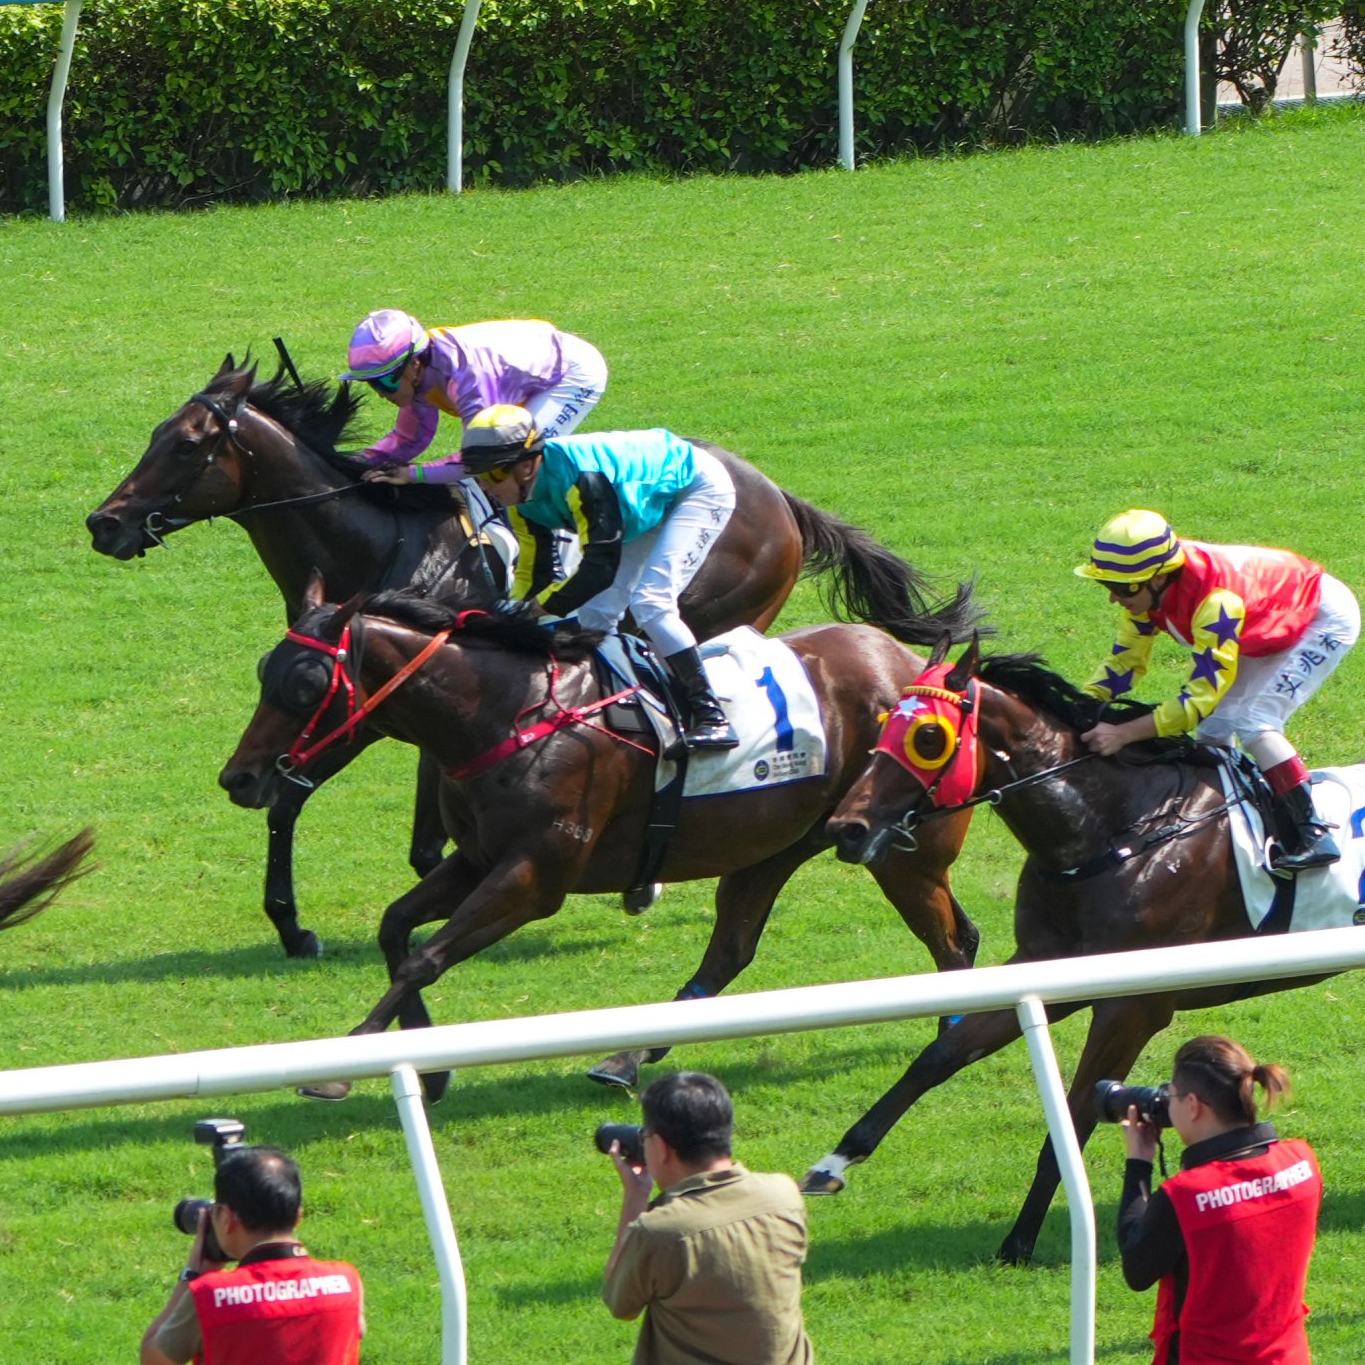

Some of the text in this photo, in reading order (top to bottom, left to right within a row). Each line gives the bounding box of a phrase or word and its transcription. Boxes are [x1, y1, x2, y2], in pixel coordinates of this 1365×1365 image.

[755, 665, 795, 752] 1
[1195, 1160, 1313, 1212] PHOTOGRAPHER
[213, 1274, 352, 1308] PHOTOGRAPHER
